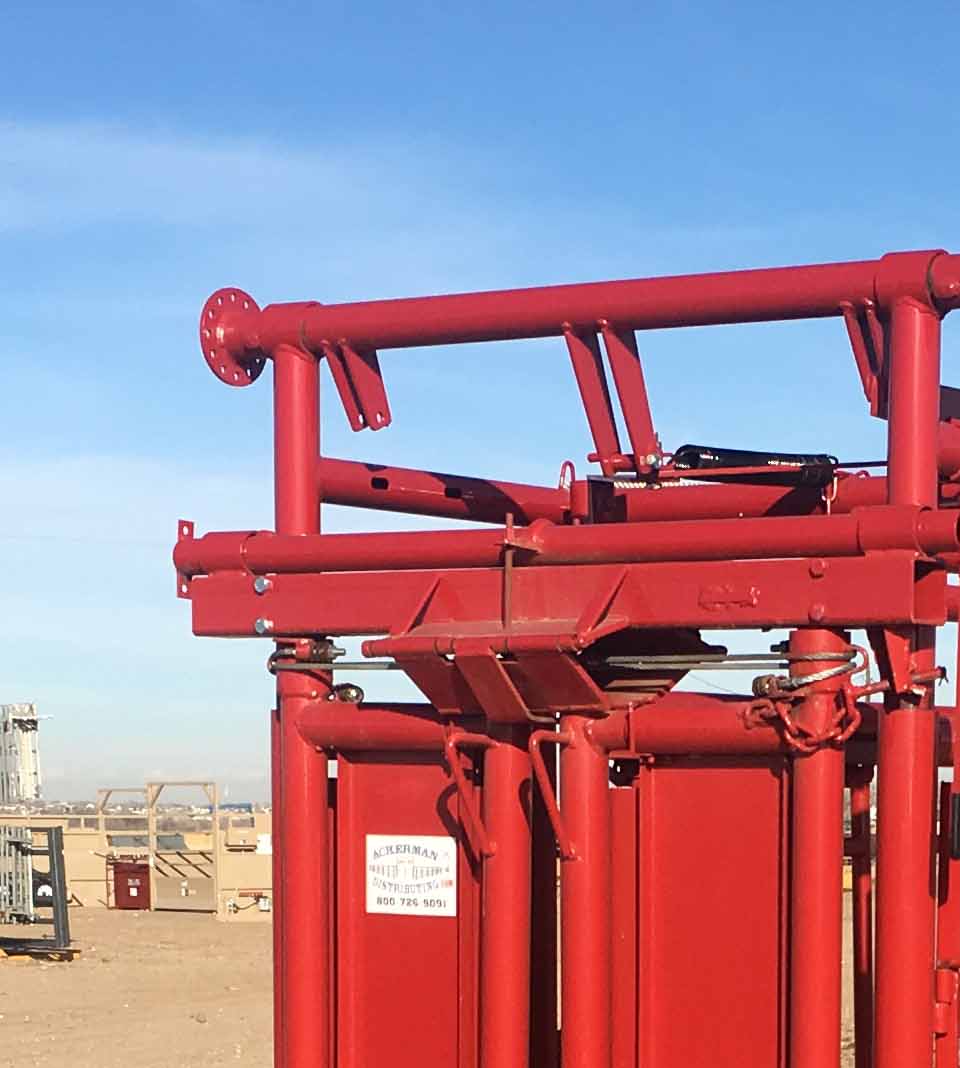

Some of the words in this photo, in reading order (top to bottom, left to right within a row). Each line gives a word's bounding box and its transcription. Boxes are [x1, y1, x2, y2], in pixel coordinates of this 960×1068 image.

[373, 844, 438, 861] ACKERMAN
[376, 896, 395, 906] 800
[400, 897, 419, 907] 726
